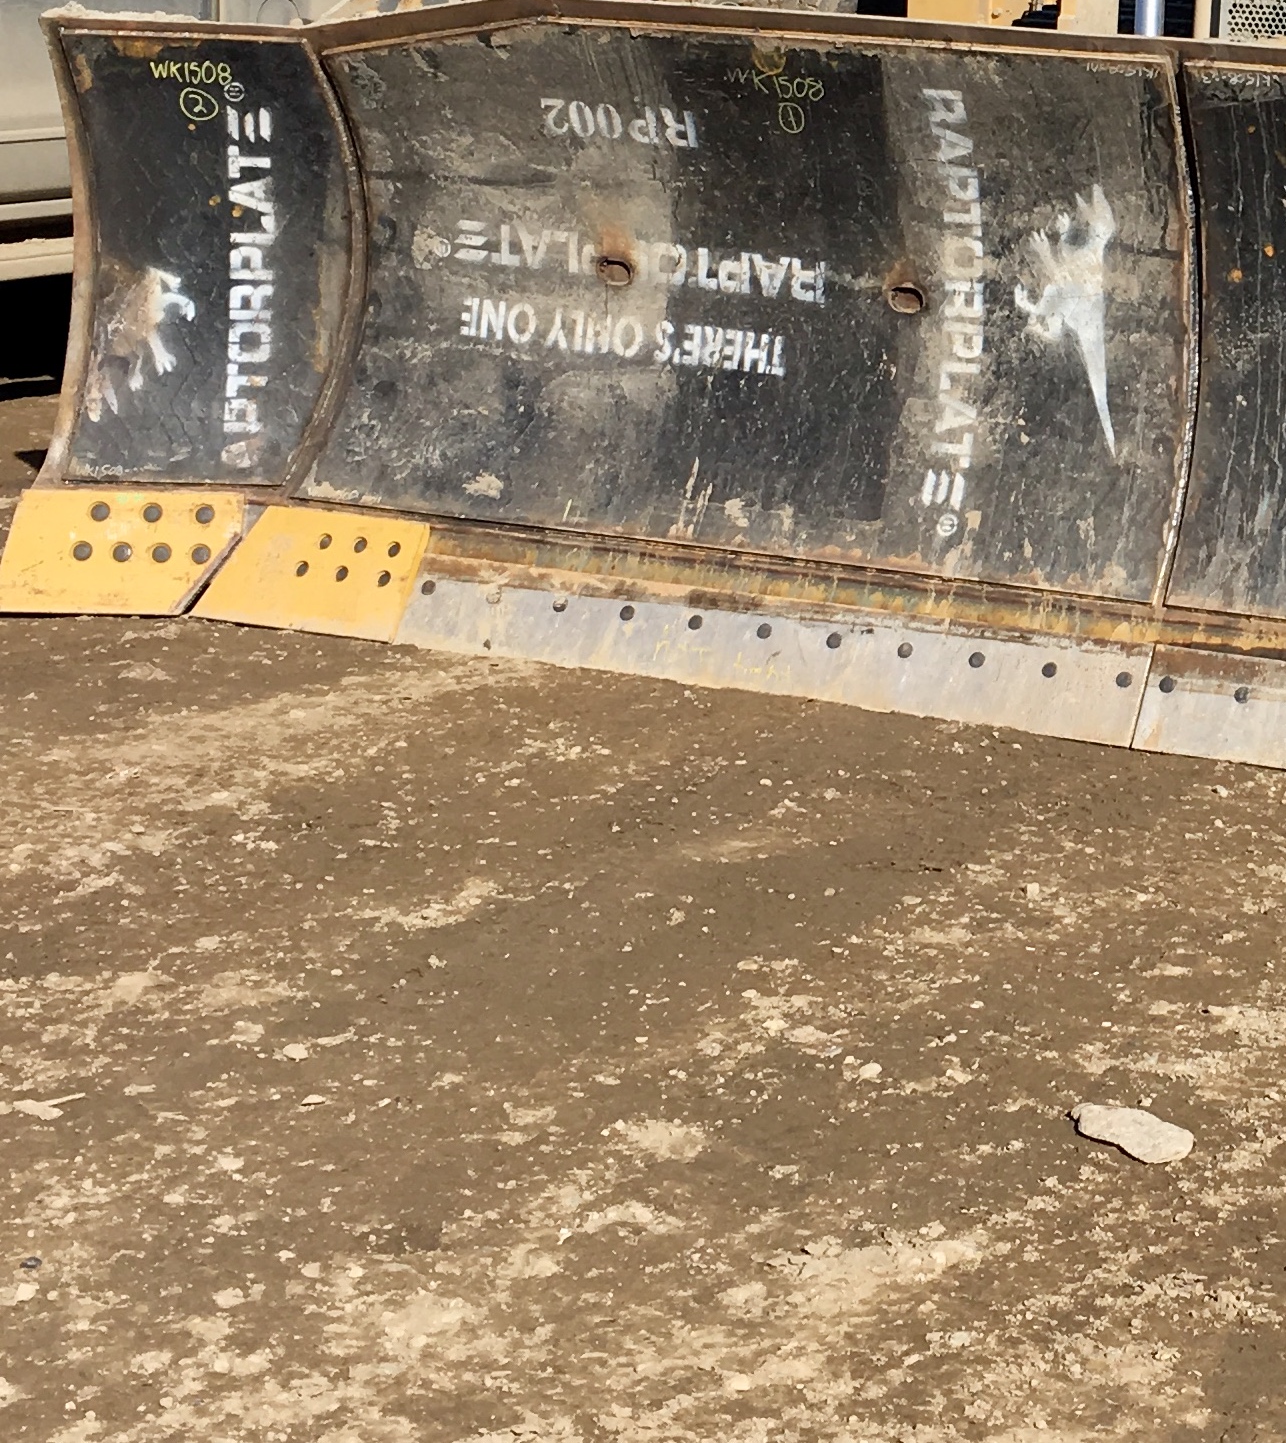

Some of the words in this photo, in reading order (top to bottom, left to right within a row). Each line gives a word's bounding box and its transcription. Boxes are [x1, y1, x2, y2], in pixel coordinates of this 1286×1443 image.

[149, 60, 233, 86] WK1508
[726, 67, 825, 102] WK1508
[460, 297, 537, 344] ONE
[545, 307, 643, 358] ONLY
[652, 319, 787, 377] THERE'S
